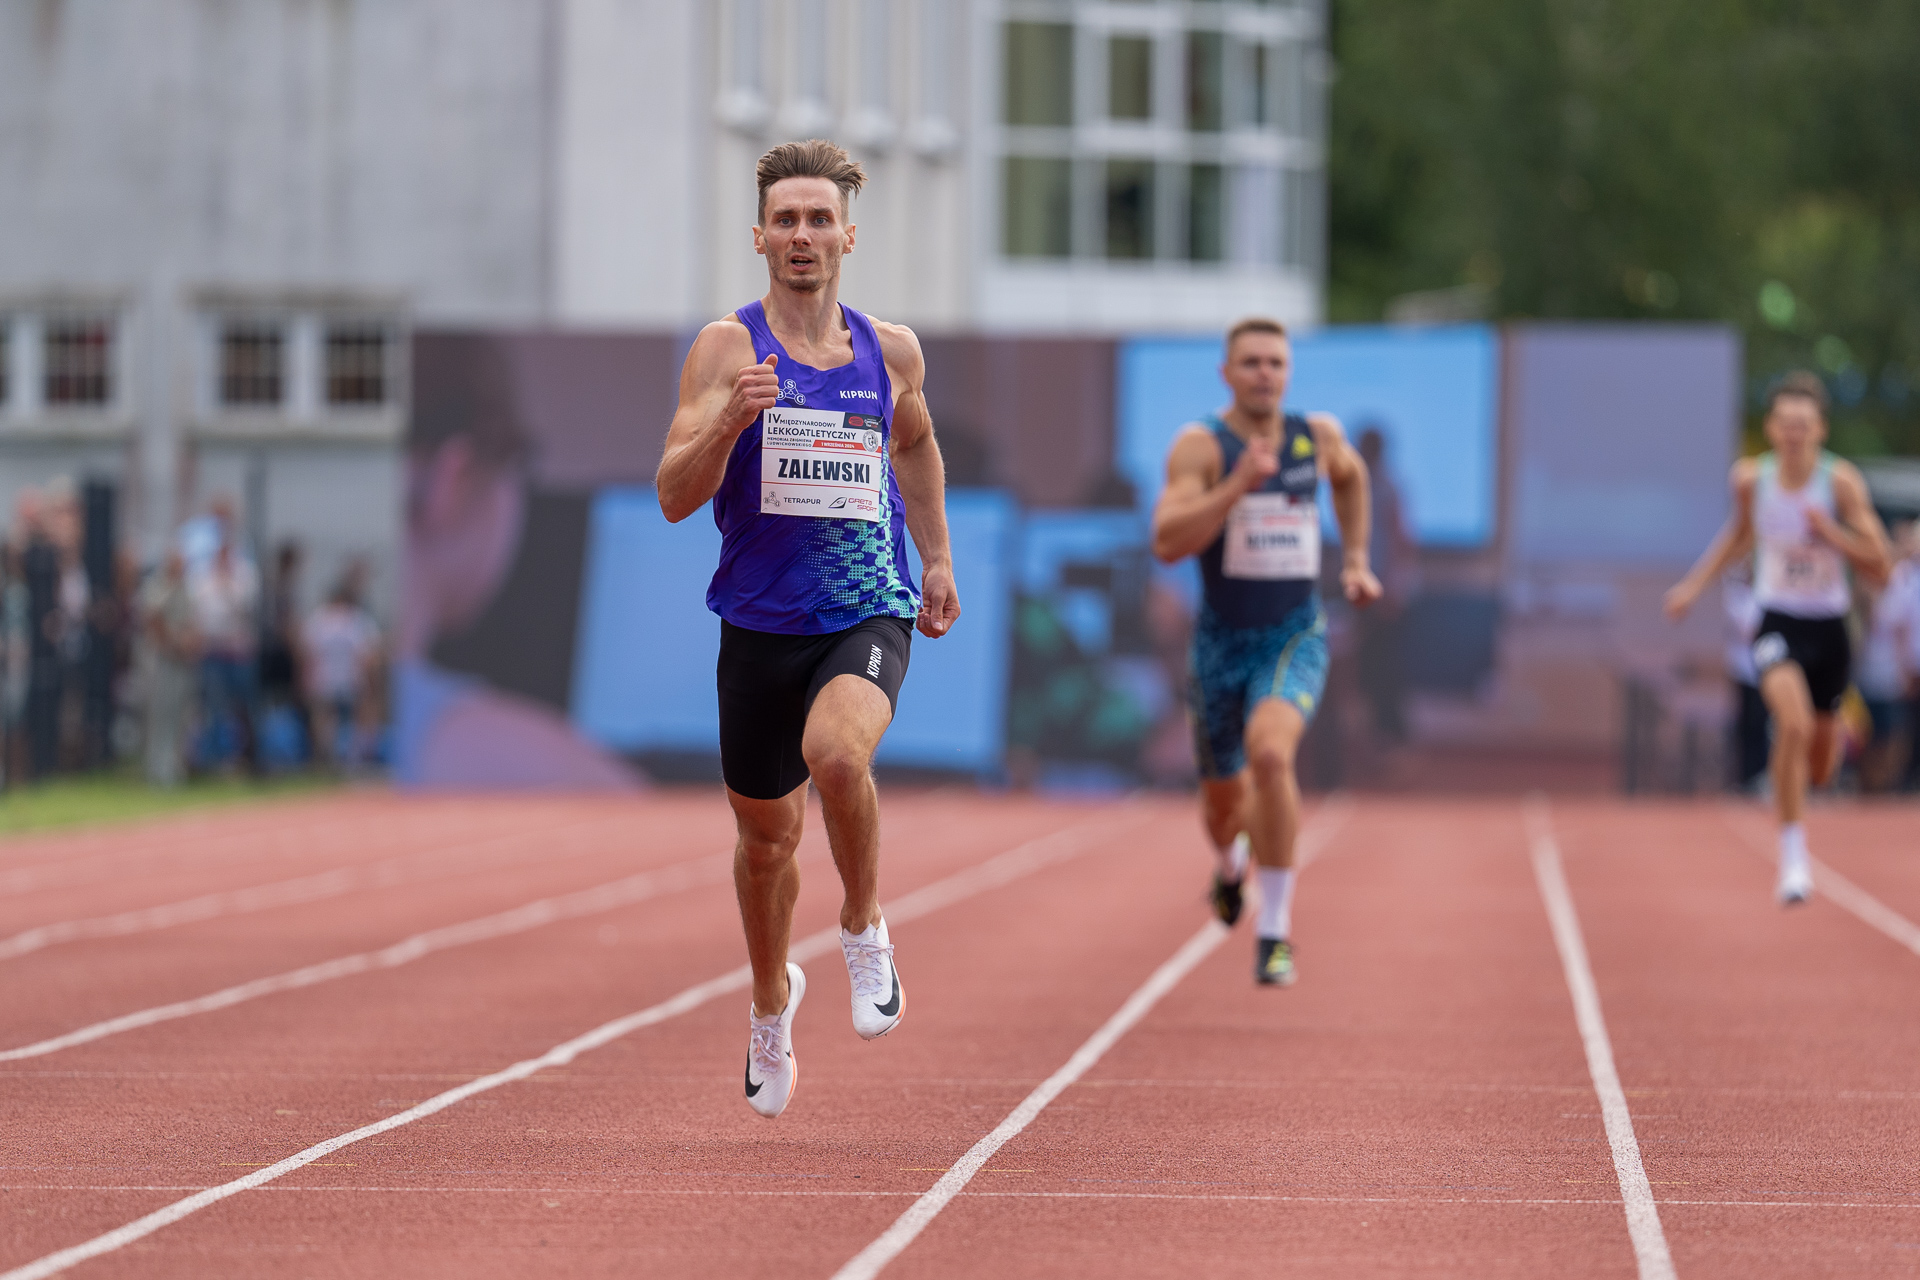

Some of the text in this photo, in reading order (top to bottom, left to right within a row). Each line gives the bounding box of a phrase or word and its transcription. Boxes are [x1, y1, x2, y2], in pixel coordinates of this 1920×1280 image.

[840, 390, 878, 400] KIPRUN
[768, 413, 837, 428] IV MIĘDZYNARODOWY
[767, 427, 857, 440] LEKKOATLETYCZNY
[778, 458, 870, 484] ZALEWSKI
[783, 496, 821, 505] TETRAPUR
[866, 643, 883, 679] KIPRUN
